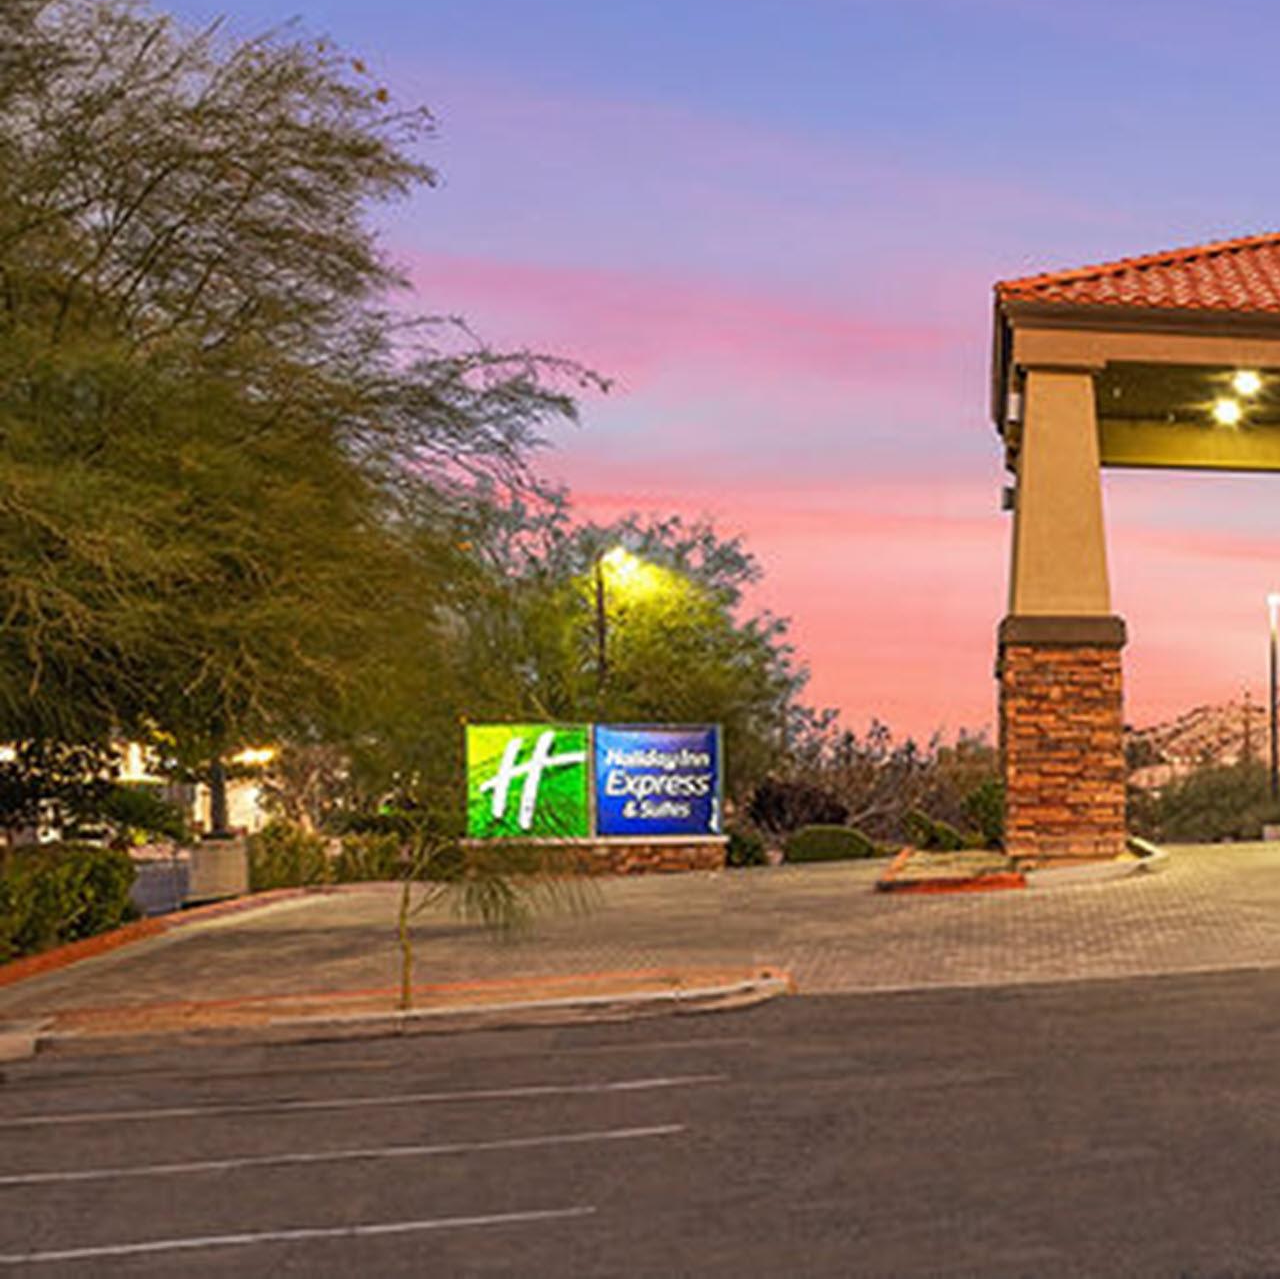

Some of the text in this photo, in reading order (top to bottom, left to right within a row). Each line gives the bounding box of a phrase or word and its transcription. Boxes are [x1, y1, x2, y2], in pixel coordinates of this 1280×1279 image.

[604, 748, 711, 771] Holiday Inn
[605, 769, 713, 800] Express
[622, 800, 692, 819] & Suites
